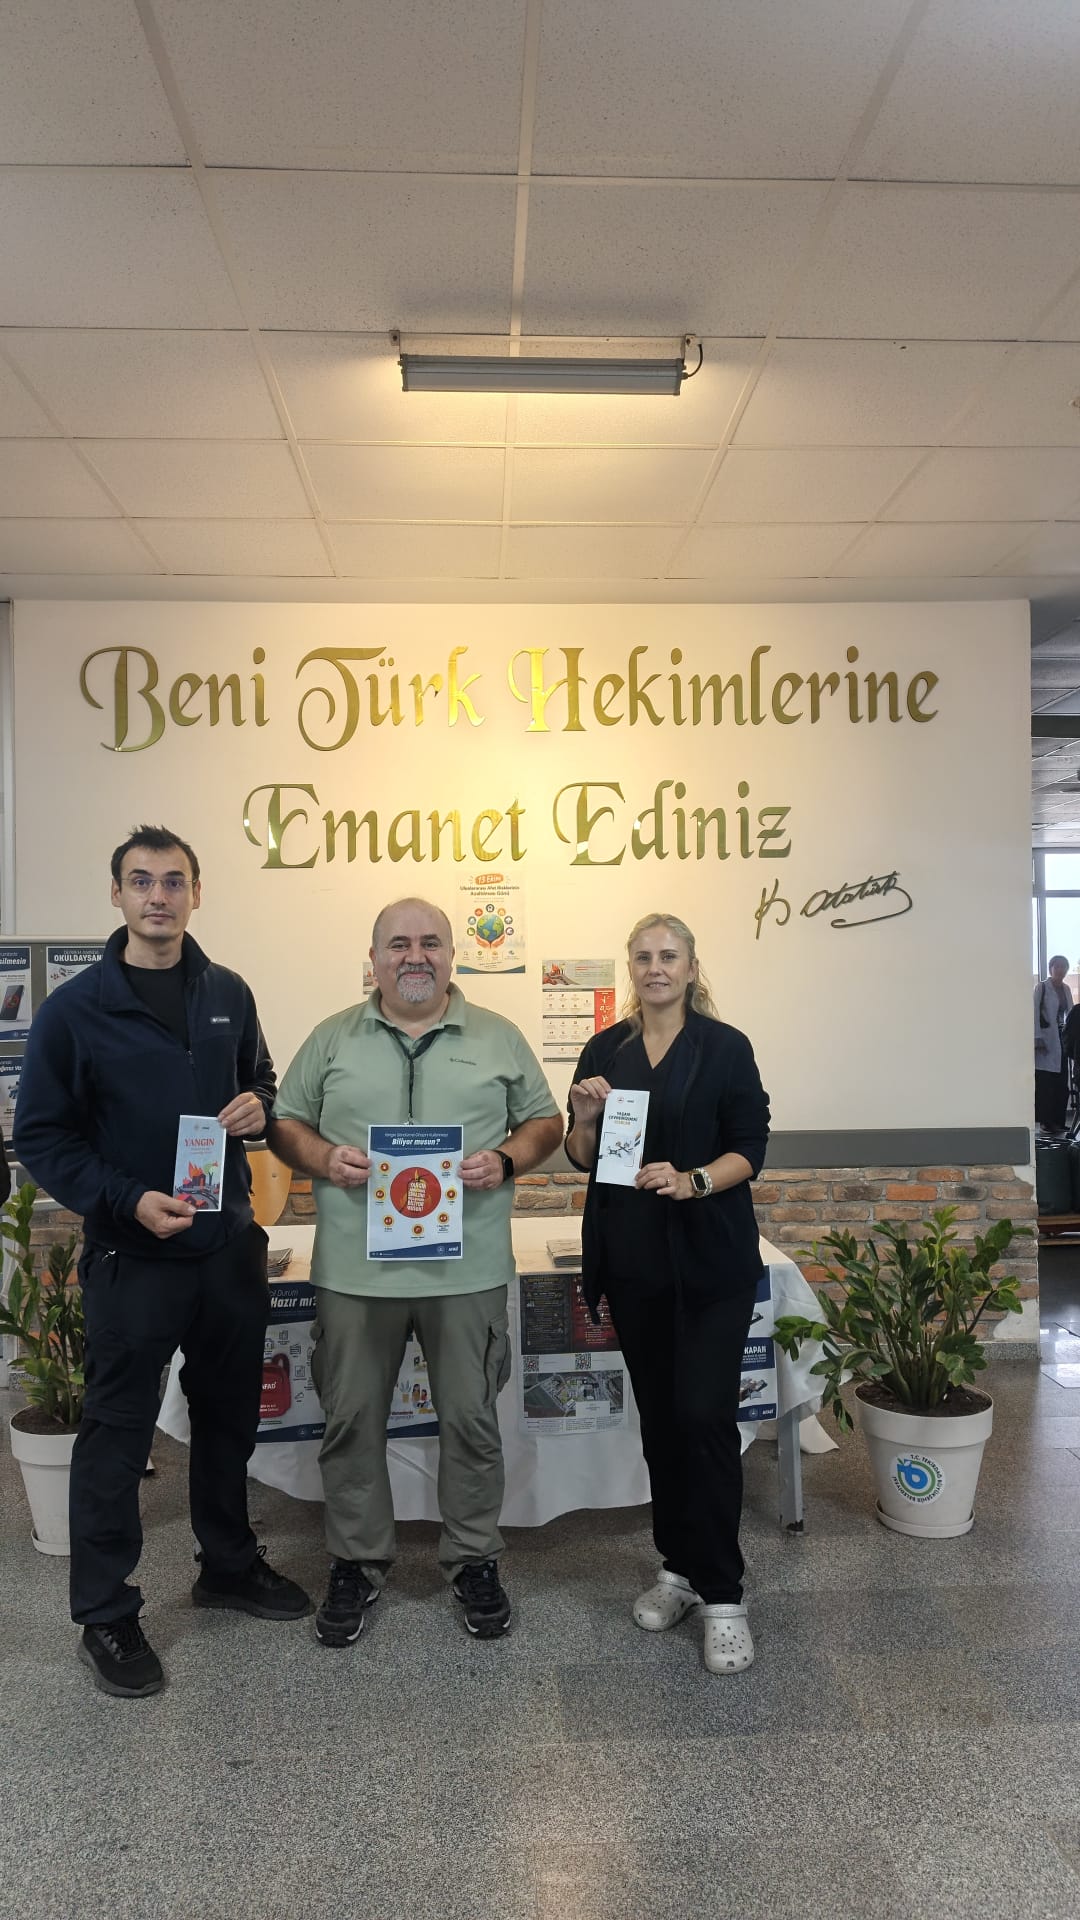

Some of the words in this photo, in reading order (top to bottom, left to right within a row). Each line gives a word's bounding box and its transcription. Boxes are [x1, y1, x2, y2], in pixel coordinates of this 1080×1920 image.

[79, 645, 270, 752] Beni
[295, 646, 486, 752] Türk
[507, 645, 940, 733] Hekimlerine
[242, 783, 528, 869] Emanet
[552, 779, 793, 866] Ediniz
[184, 1138, 215, 1147] YANGIN
[392, 1138, 414, 1146] Biliyor
[270, 1297, 298, 1308] Hazır
[744, 1345, 767, 1355] KAPAN
